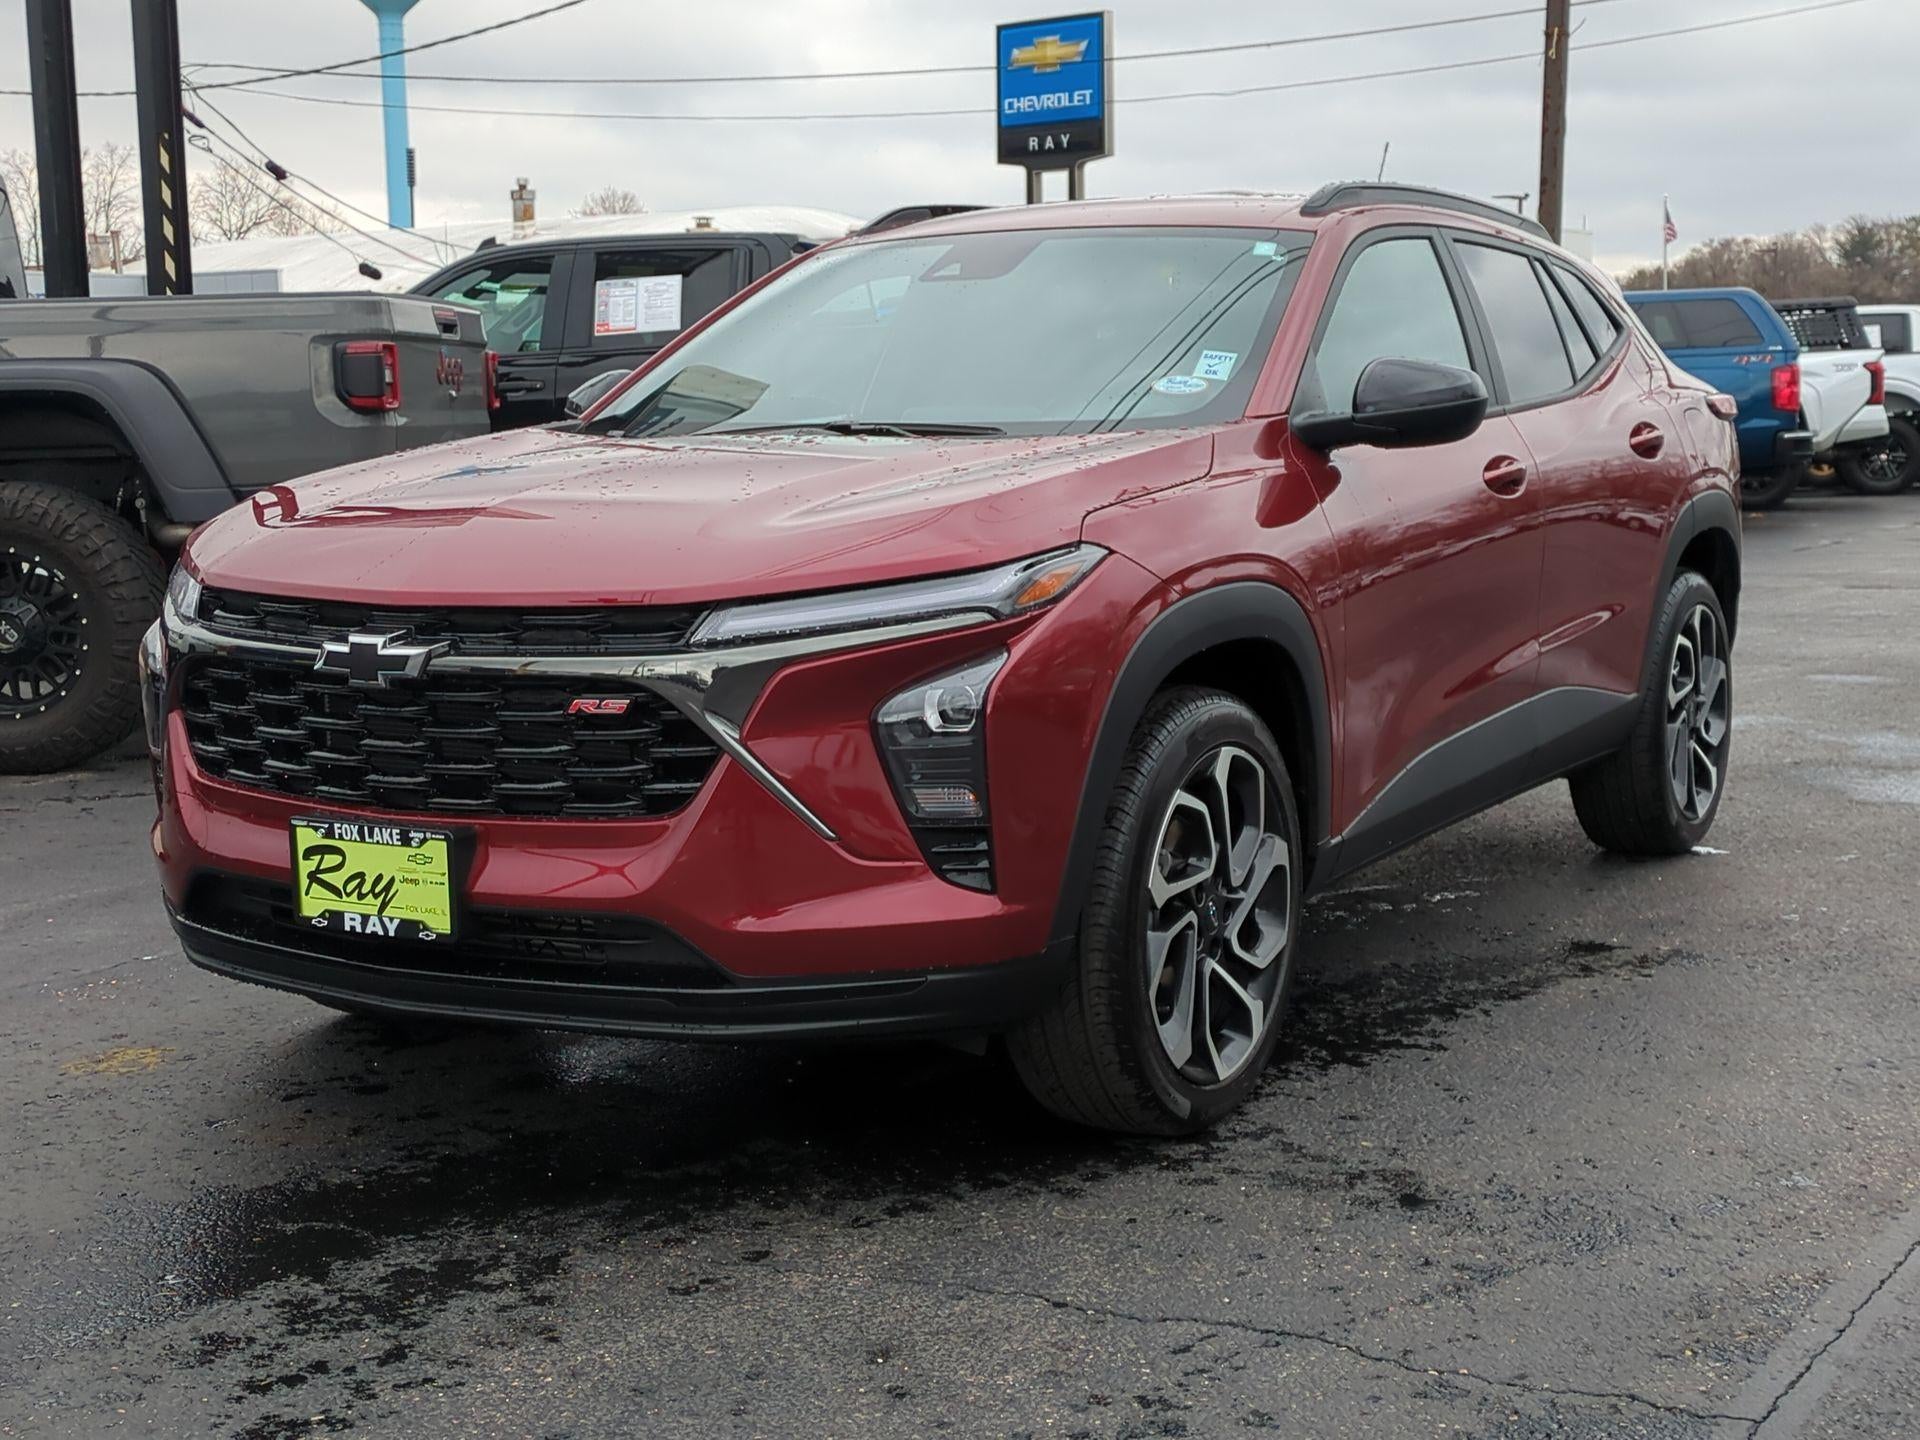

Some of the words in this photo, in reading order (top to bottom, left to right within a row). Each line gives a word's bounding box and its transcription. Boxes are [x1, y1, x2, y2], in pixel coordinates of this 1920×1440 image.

[1004, 89, 1093, 113] CHEVROLET
[1029, 133, 1070, 151] RAY
[1203, 353, 1233, 361] SAFETY
[436, 346, 463, 393] Jeep
[1204, 368, 1219, 376] OK
[568, 699, 630, 714] RS
[333, 823, 359, 841] FOX
[363, 825, 402, 846] LAKE
[408, 830, 424, 840] Jeep
[302, 844, 400, 917] Ray
[399, 875, 420, 887] Jeep
[405, 904, 419, 913] FOX
[344, 912, 401, 937] RAY
